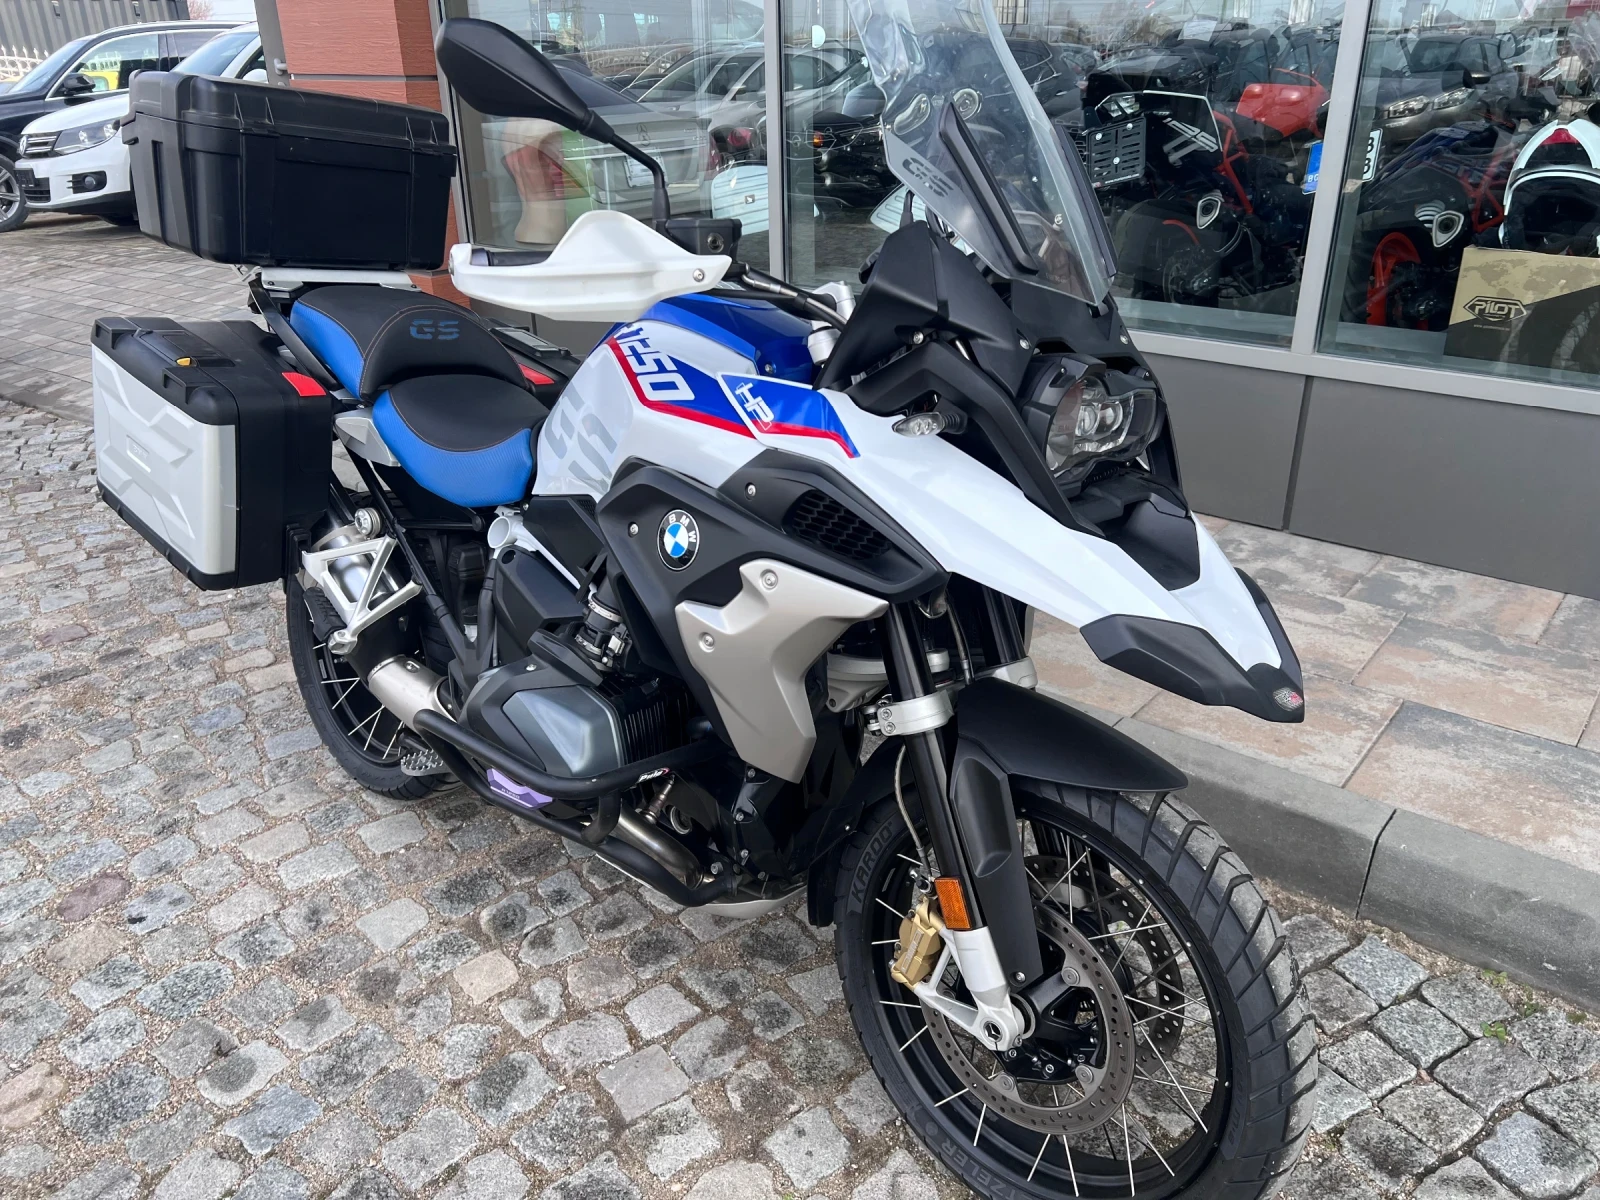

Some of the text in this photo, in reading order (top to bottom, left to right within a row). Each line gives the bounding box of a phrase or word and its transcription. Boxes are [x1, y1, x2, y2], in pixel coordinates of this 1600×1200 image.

[902, 157, 955, 198] GS
[409, 319, 461, 340] GS
[613, 324, 696, 402] 1250
[735, 381, 776, 431] HP
[668, 513, 698, 543] BMW
[850, 825, 894, 904] KAROO
